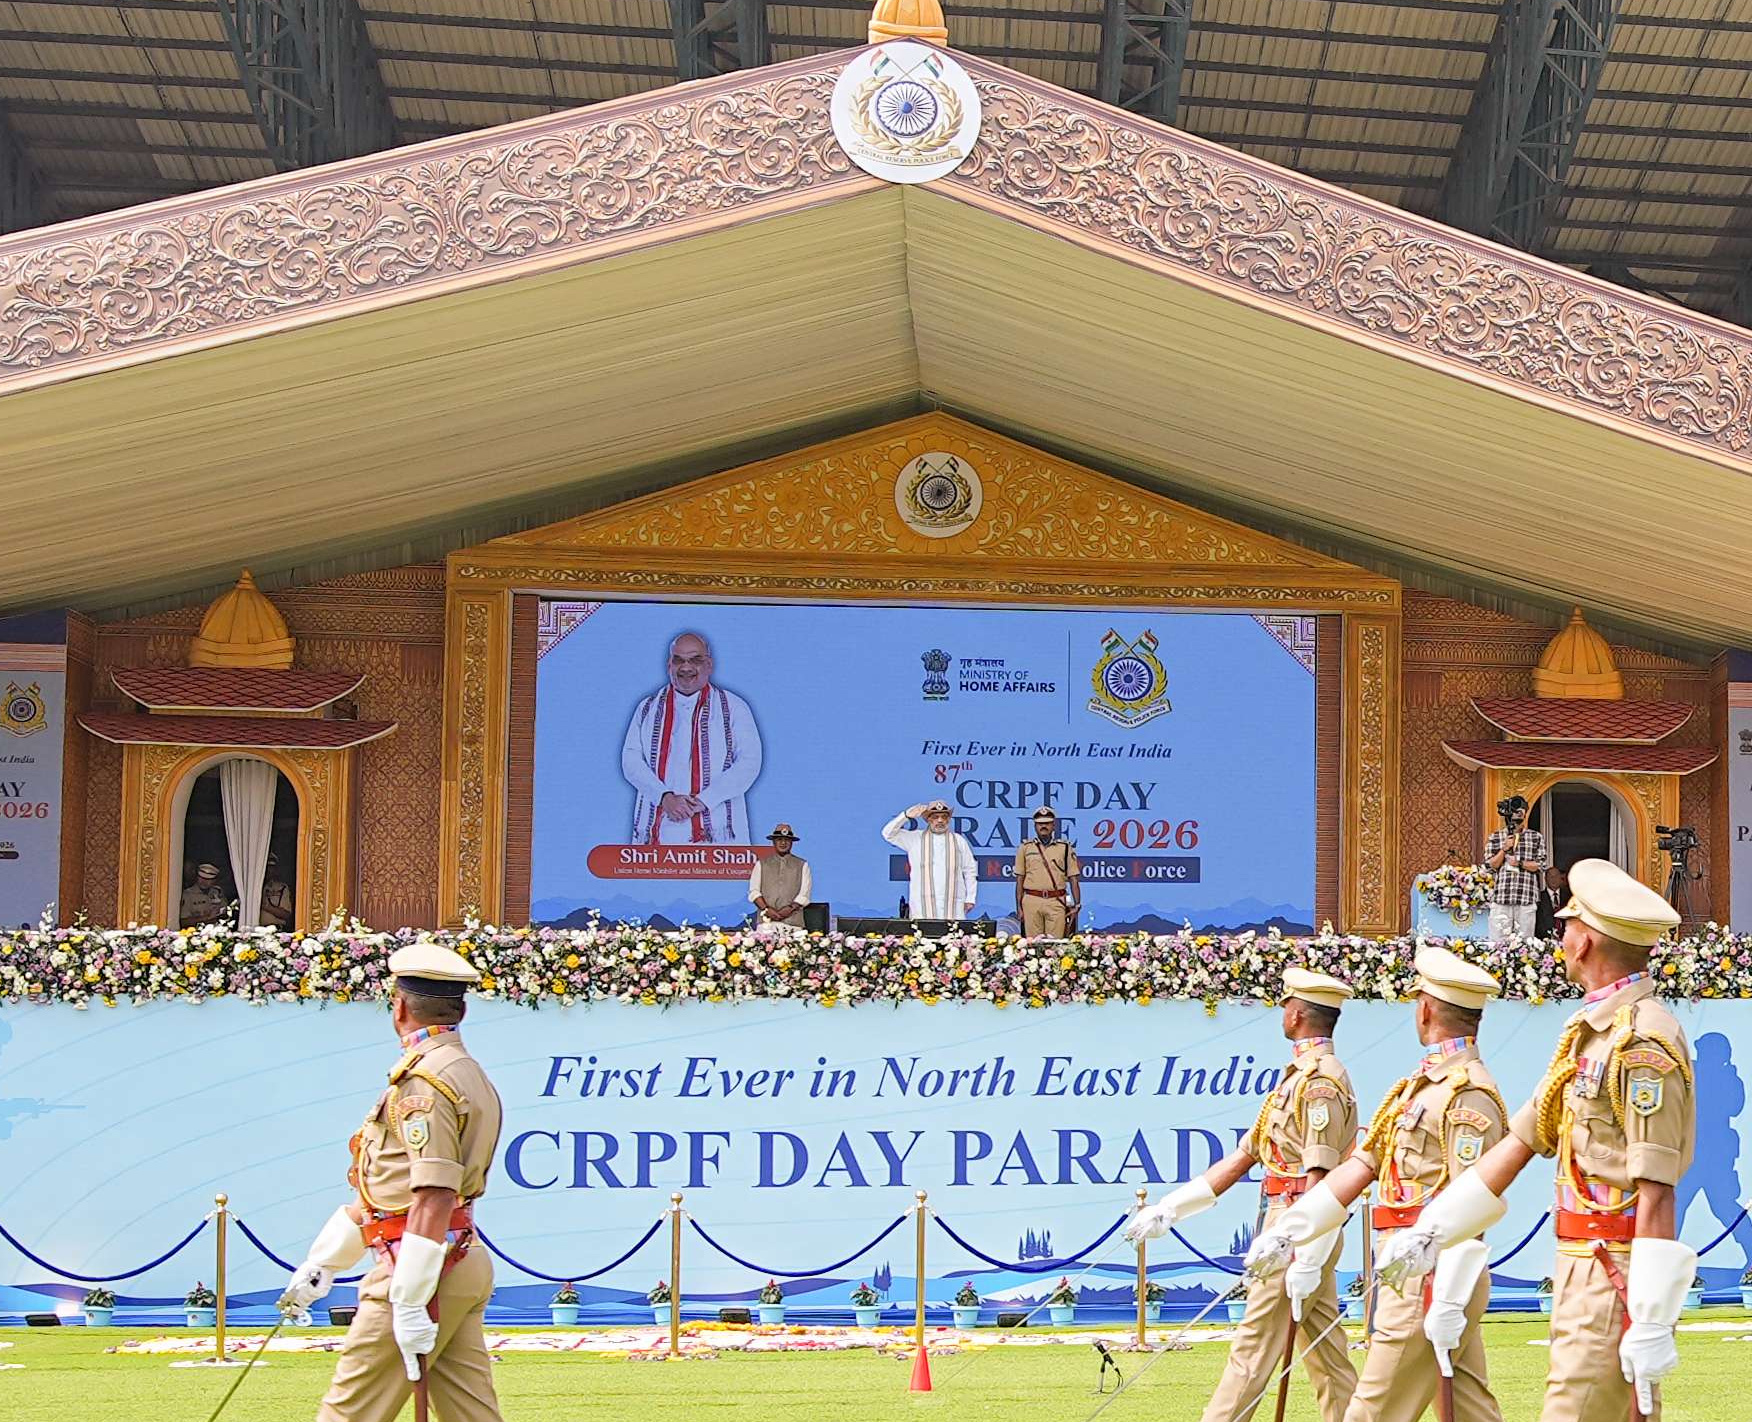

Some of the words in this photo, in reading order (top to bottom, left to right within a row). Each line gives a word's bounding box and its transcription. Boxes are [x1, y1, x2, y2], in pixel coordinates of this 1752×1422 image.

[959, 670, 1012, 680] MINISTRY
[1014, 670, 1030, 680] OF
[959, 681, 1000, 692] HOME
[1003, 682, 1056, 693] AFFAIRS
[8, 755, 35, 763] India
[921, 740, 962, 756] First
[966, 741, 1006, 756] Ever
[1010, 742, 1026, 757] in
[1032, 742, 1081, 757] North
[1086, 743, 1124, 758] East
[1128, 743, 1172, 759] India
[934, 761, 973, 784] 87th
[955, 779, 1064, 810] CRPF
[1074, 781, 1158, 810] DAY
[1092, 819, 1199, 849] 2026
[620, 848, 658, 864] Shri
[663, 849, 707, 864] Amit
[712, 849, 757, 864] Shah
[1077, 860, 1126, 878] olice
[538, 1056, 663, 1097] First
[674, 1057, 792, 1097] Ever
[809, 1057, 857, 1097] in
[872, 1055, 1016, 1098] North
[1032, 1056, 1141, 1097] East
[1152, 1055, 1280, 1097] India
[504, 1130, 731, 1189] CRPF
[751, 1130, 927, 1188] DAY
